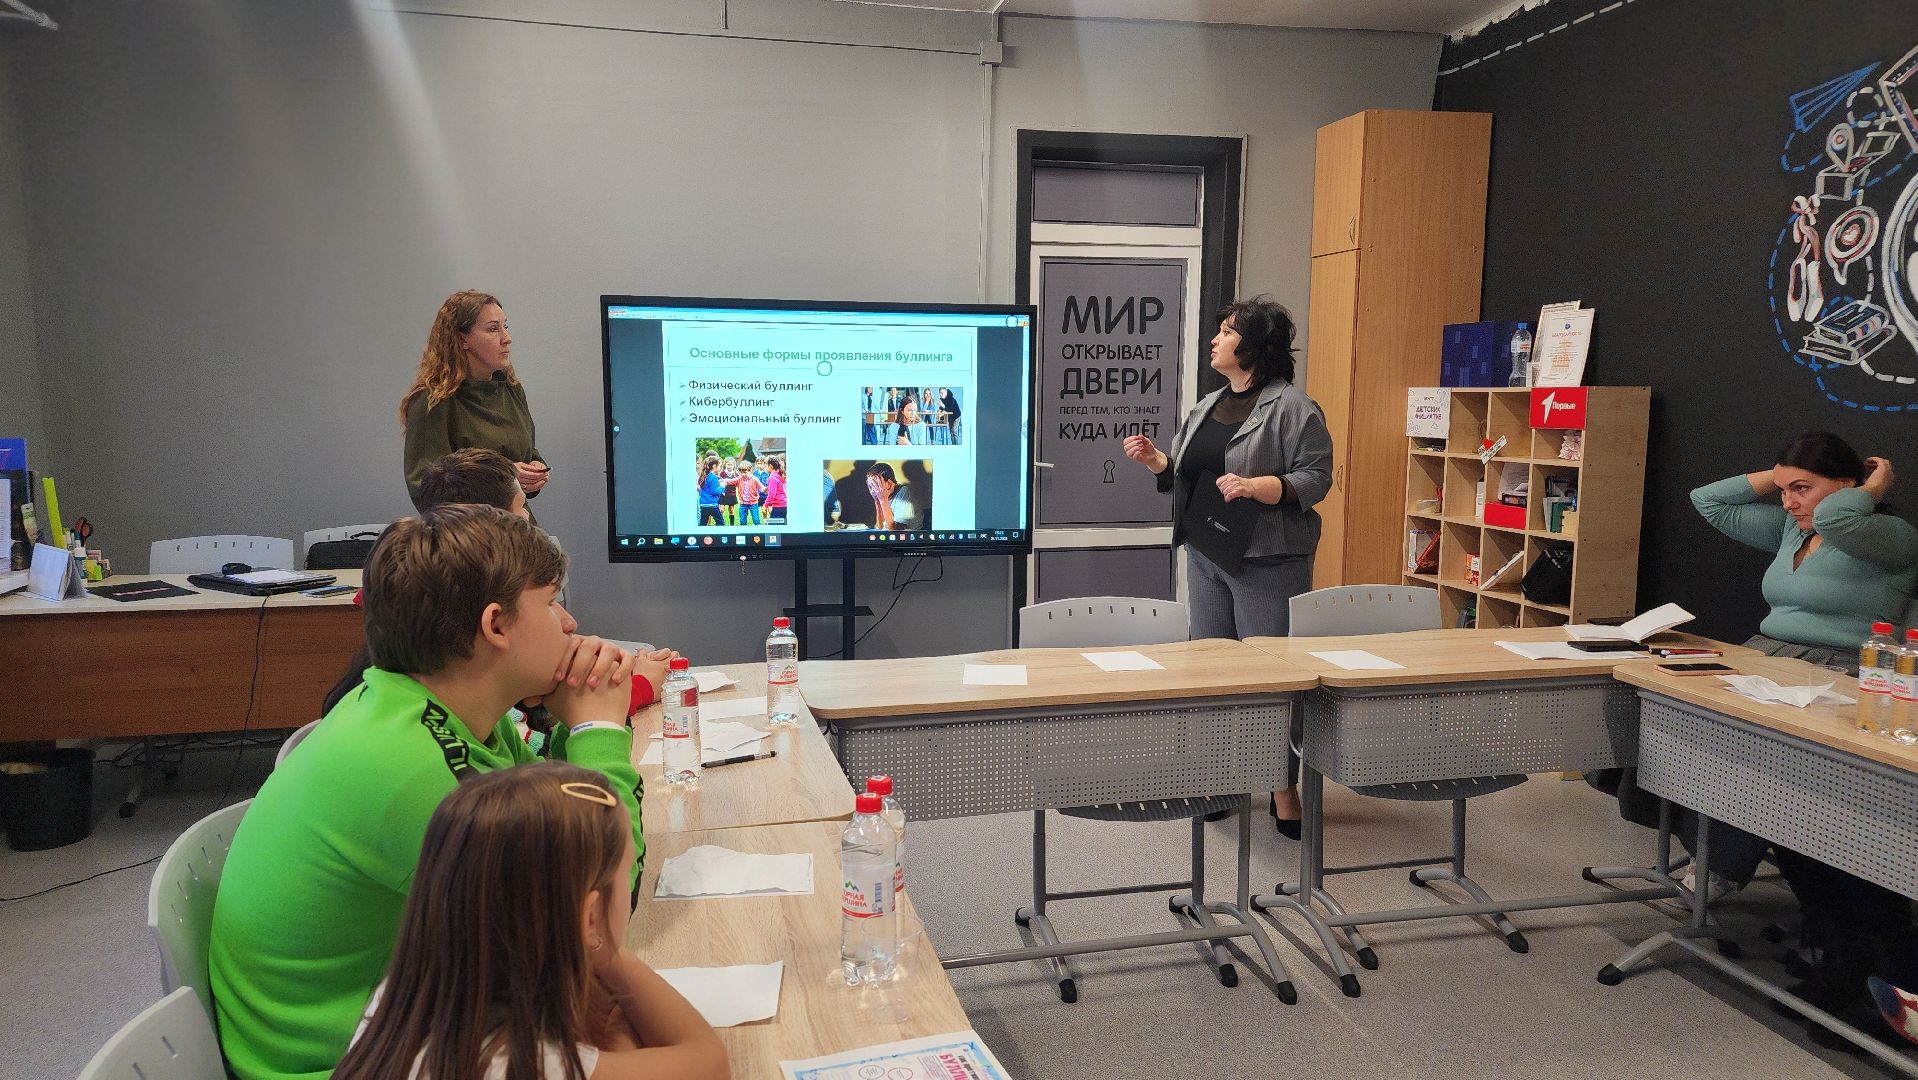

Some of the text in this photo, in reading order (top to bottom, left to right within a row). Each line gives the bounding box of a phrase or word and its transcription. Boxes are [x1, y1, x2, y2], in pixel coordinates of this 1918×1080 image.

[1061, 295, 1164, 335] МИР
[689, 347, 953, 364] Основные формы проявления буллинга
[1061, 343, 1163, 361] ОТКРЫВАЕТ
[688, 379, 813, 394] Физический буллинг
[1060, 367, 1161, 399] ДВЕРИ
[689, 396, 774, 410] Кибербуллинг
[1059, 406, 1160, 416] ПЕРЕД ТЕМ, КТО ЗНАЕТ
[1552, 401, 1576, 411] Первые
[689, 412, 842, 427] Эмоциональный буллинг
[1059, 422, 1107, 442] КУДА
